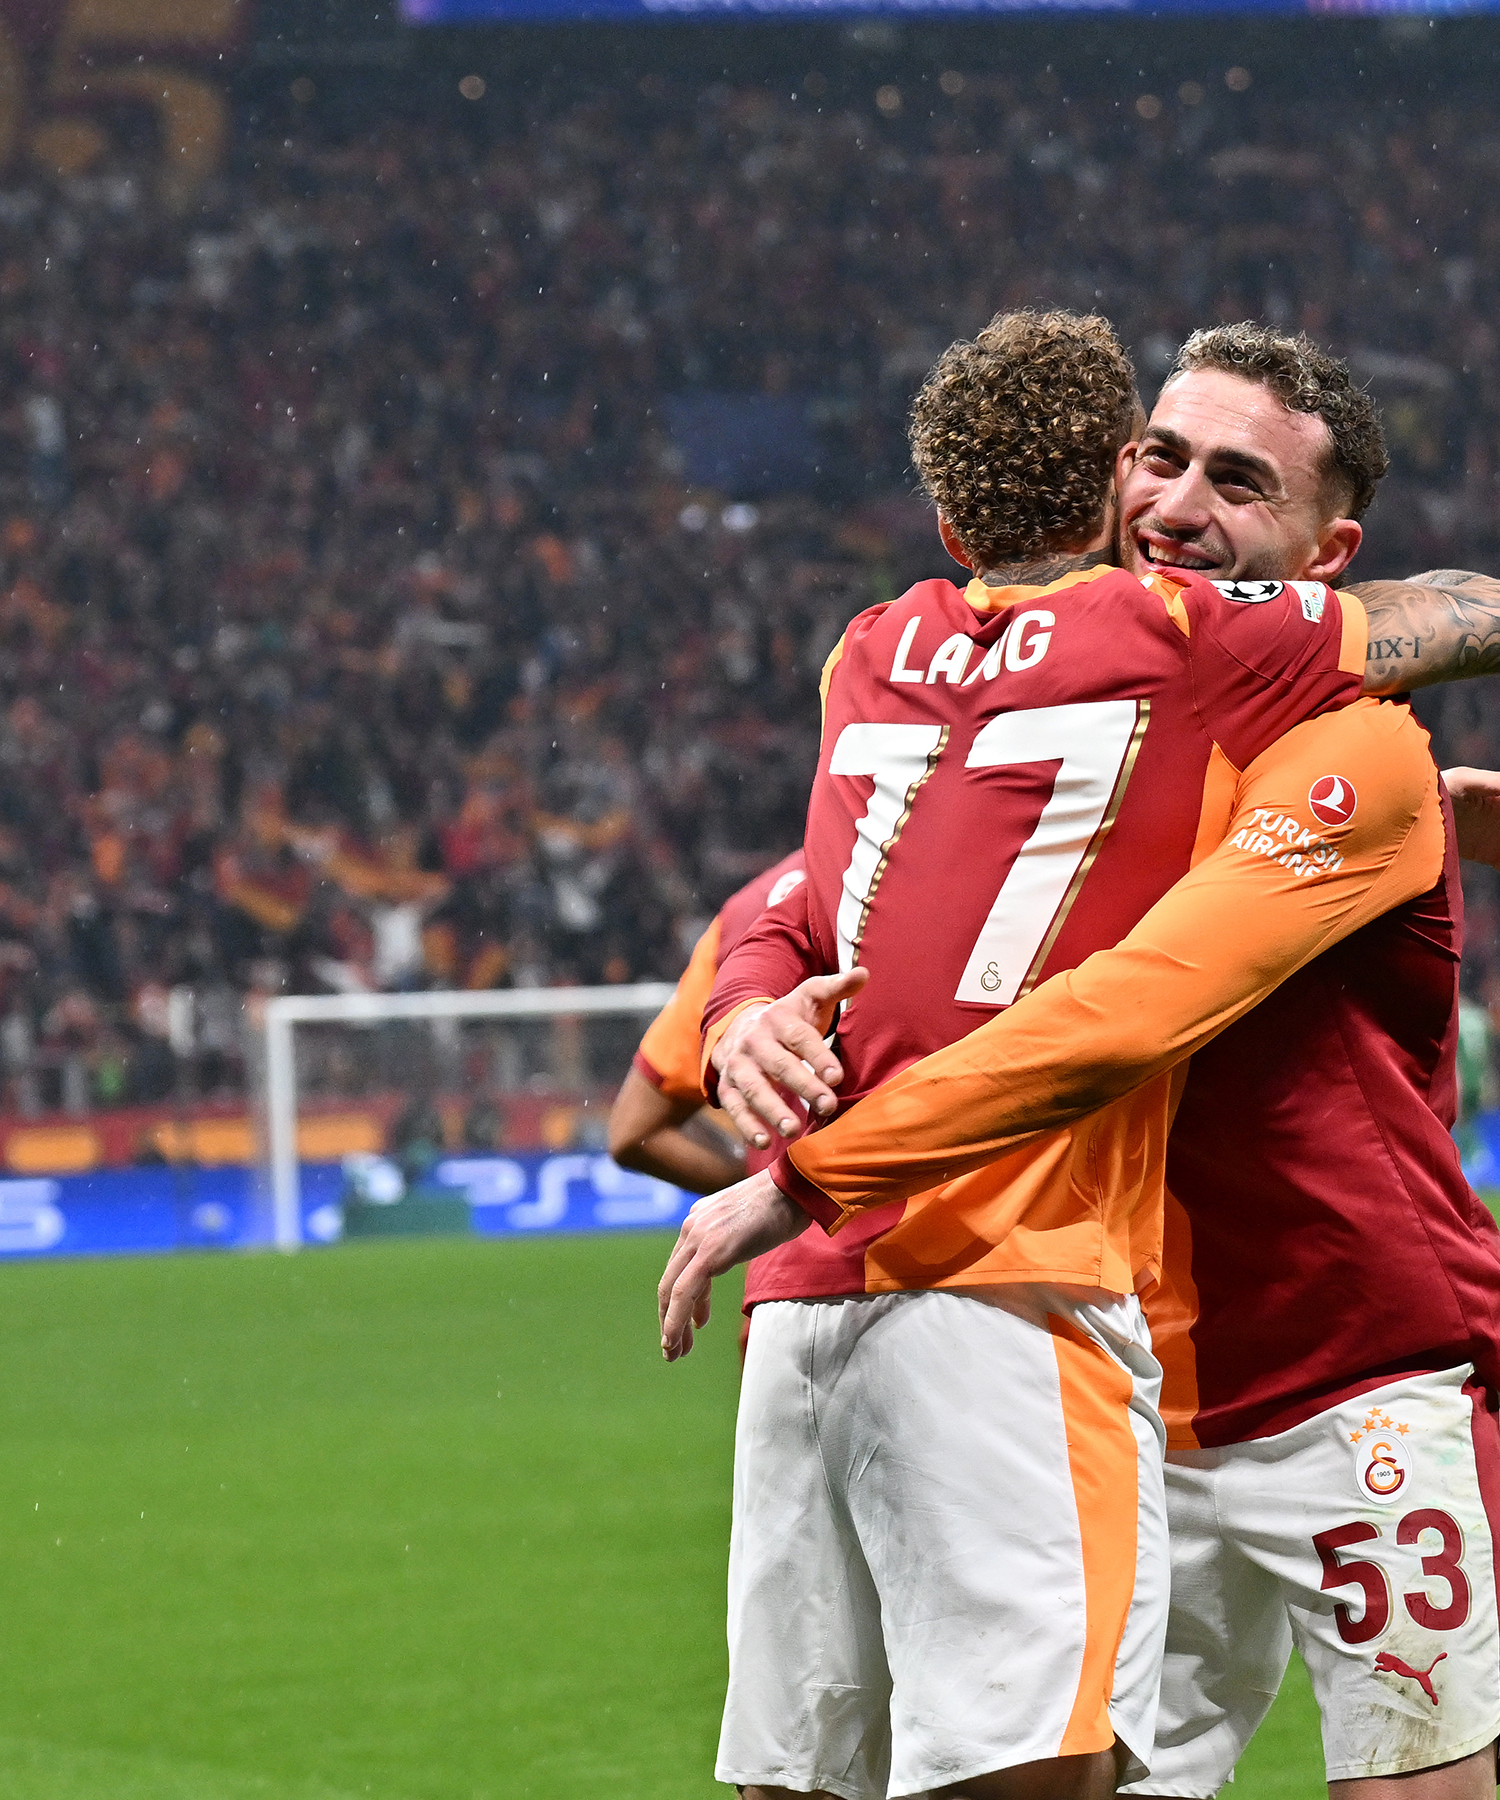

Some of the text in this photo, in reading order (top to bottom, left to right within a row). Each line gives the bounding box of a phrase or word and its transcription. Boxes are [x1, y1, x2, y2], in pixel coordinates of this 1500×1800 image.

[829, 700, 1151, 1010] 77
[1247, 808, 1344, 872] TURKISH
[1311, 1508, 1473, 1645] 53
